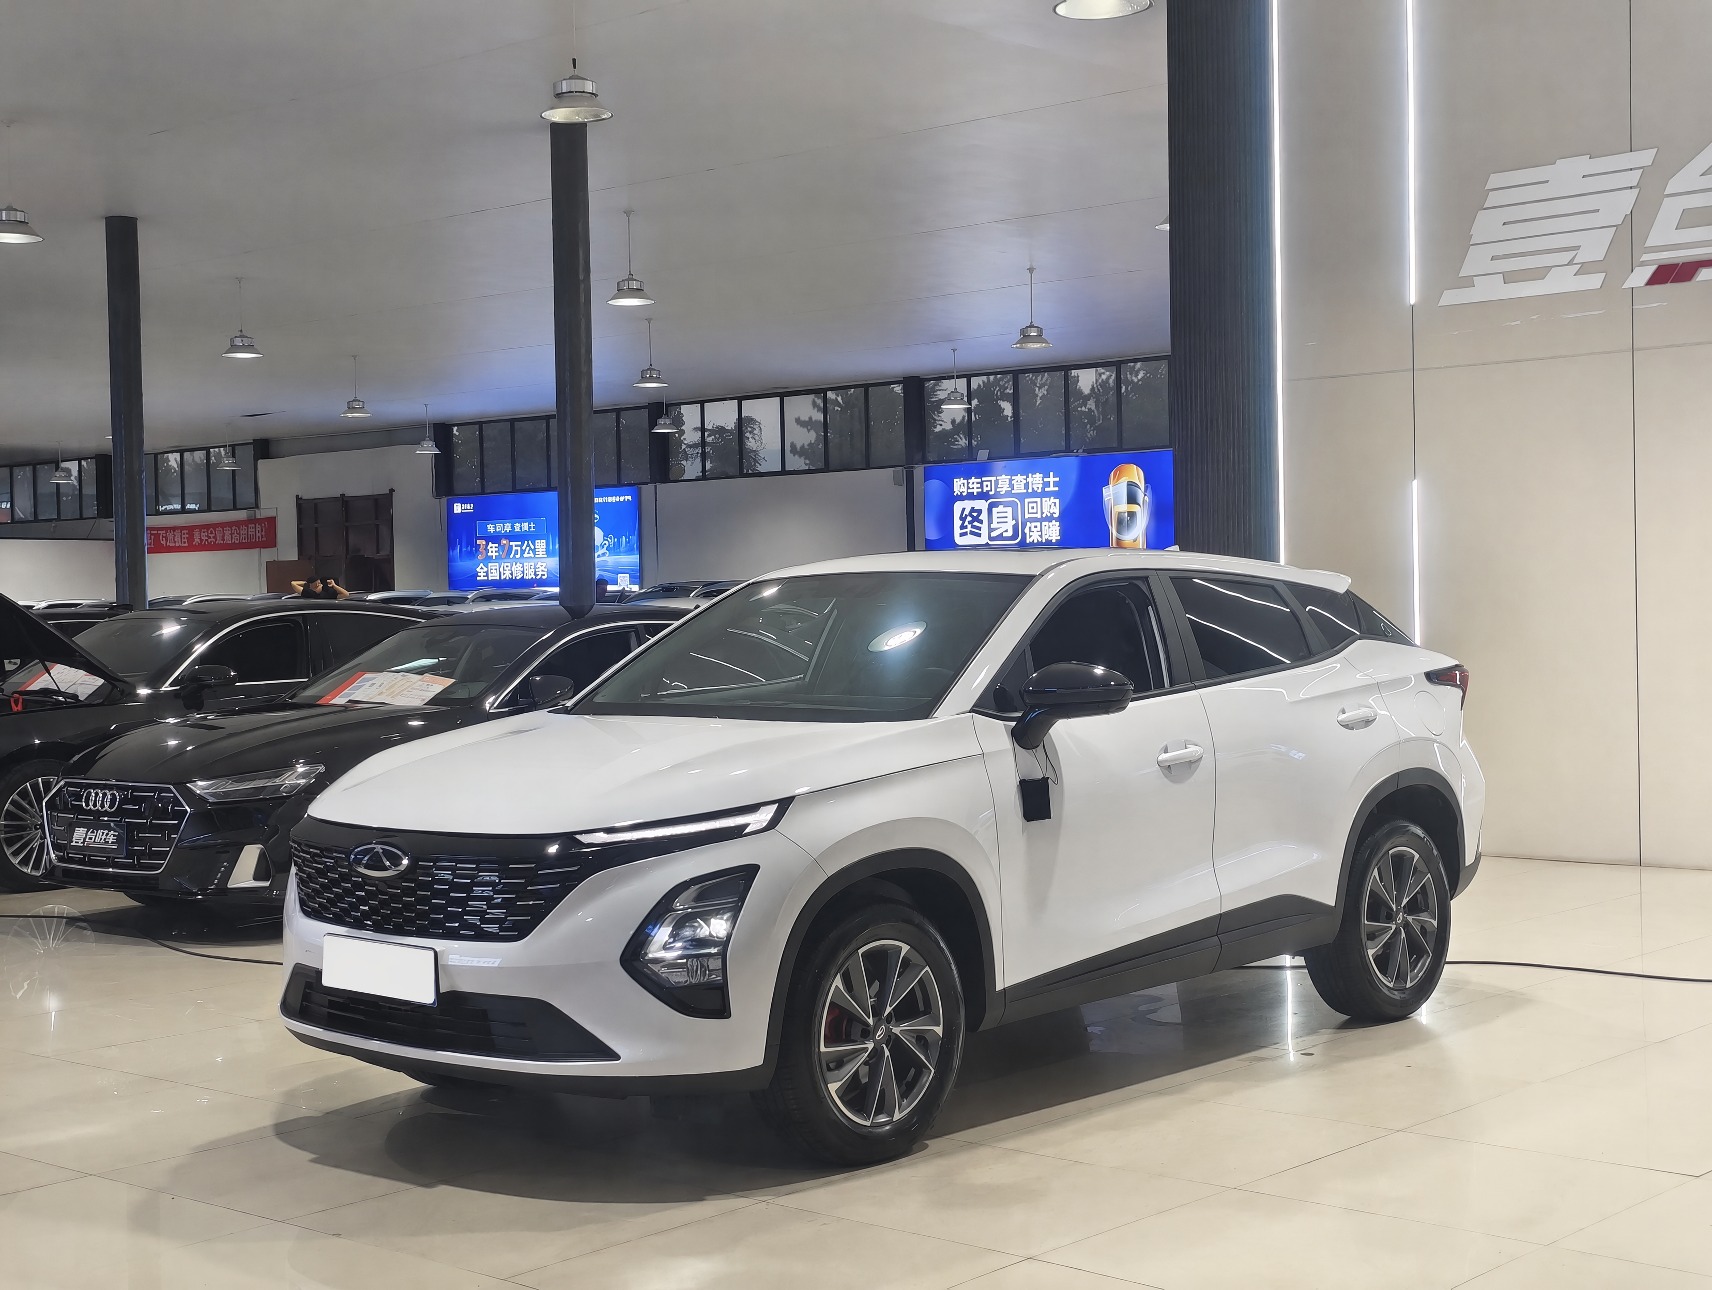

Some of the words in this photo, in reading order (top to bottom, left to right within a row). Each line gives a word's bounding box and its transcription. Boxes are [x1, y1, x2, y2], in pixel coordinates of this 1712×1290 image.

[953, 472, 1060, 496] 购车可享查博士
[1024, 497, 1060, 519] 回购
[957, 504, 1017, 539] 终身
[1024, 521, 1061, 543] 保障
[476, 561, 548, 581] 全国保修服务
[70, 827, 119, 847] 壹台好车
